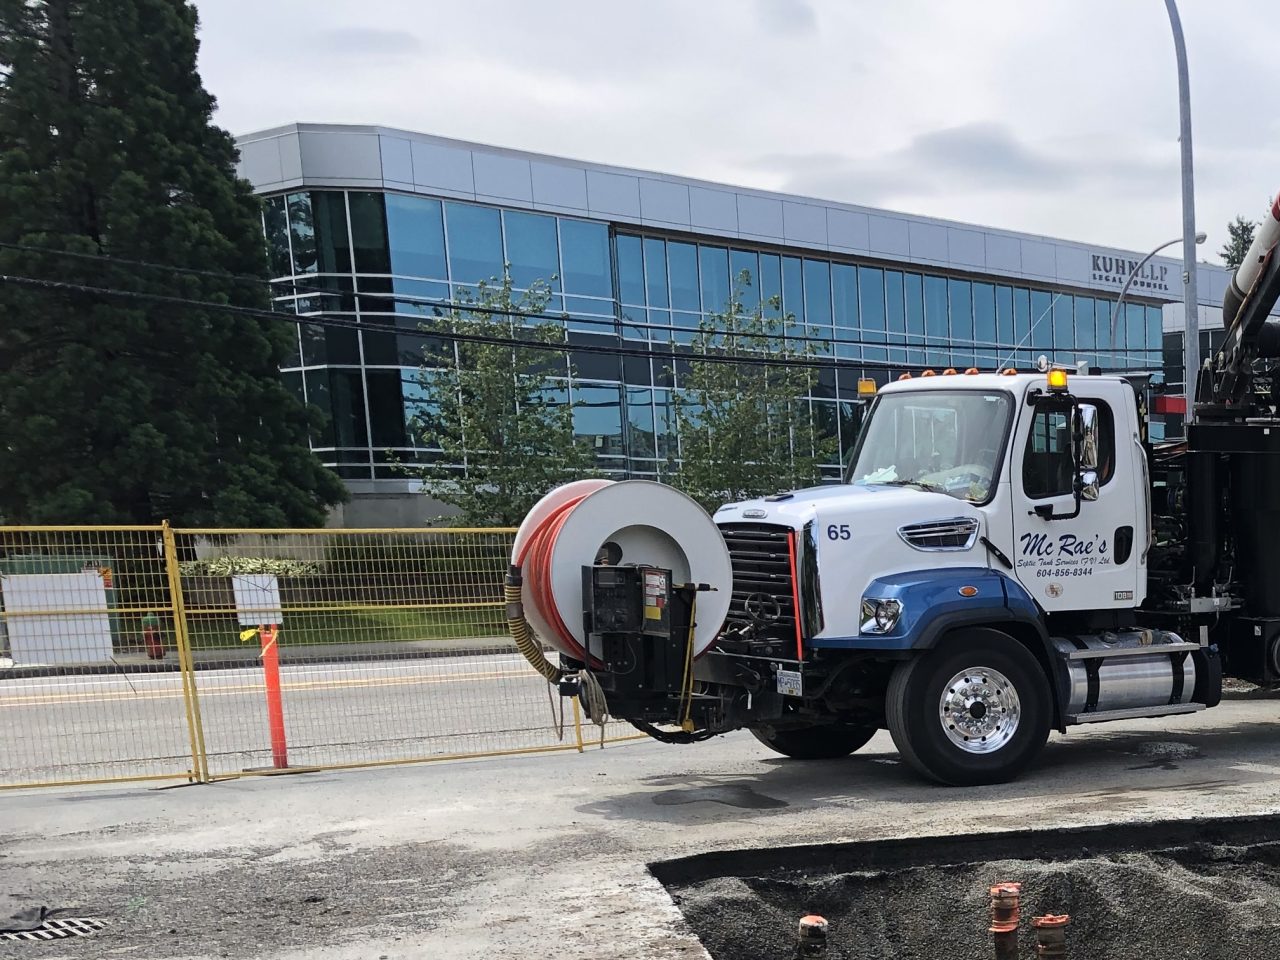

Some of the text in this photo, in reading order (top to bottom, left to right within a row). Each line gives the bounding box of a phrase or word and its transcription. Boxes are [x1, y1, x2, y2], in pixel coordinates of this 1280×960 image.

[1092, 254, 1168, 282] KUHN LLP
[1092, 273, 1169, 291] LEGAL OUNSEL
[827, 524, 851, 541] 65
[1057, 533, 1108, 557] Rae's
[1016, 559, 1036, 568] Septic
[1039, 557, 1053, 566] Tank
[1055, 557, 1079, 567] Services
[1036, 567, 1093, 578] 604-856-8344
